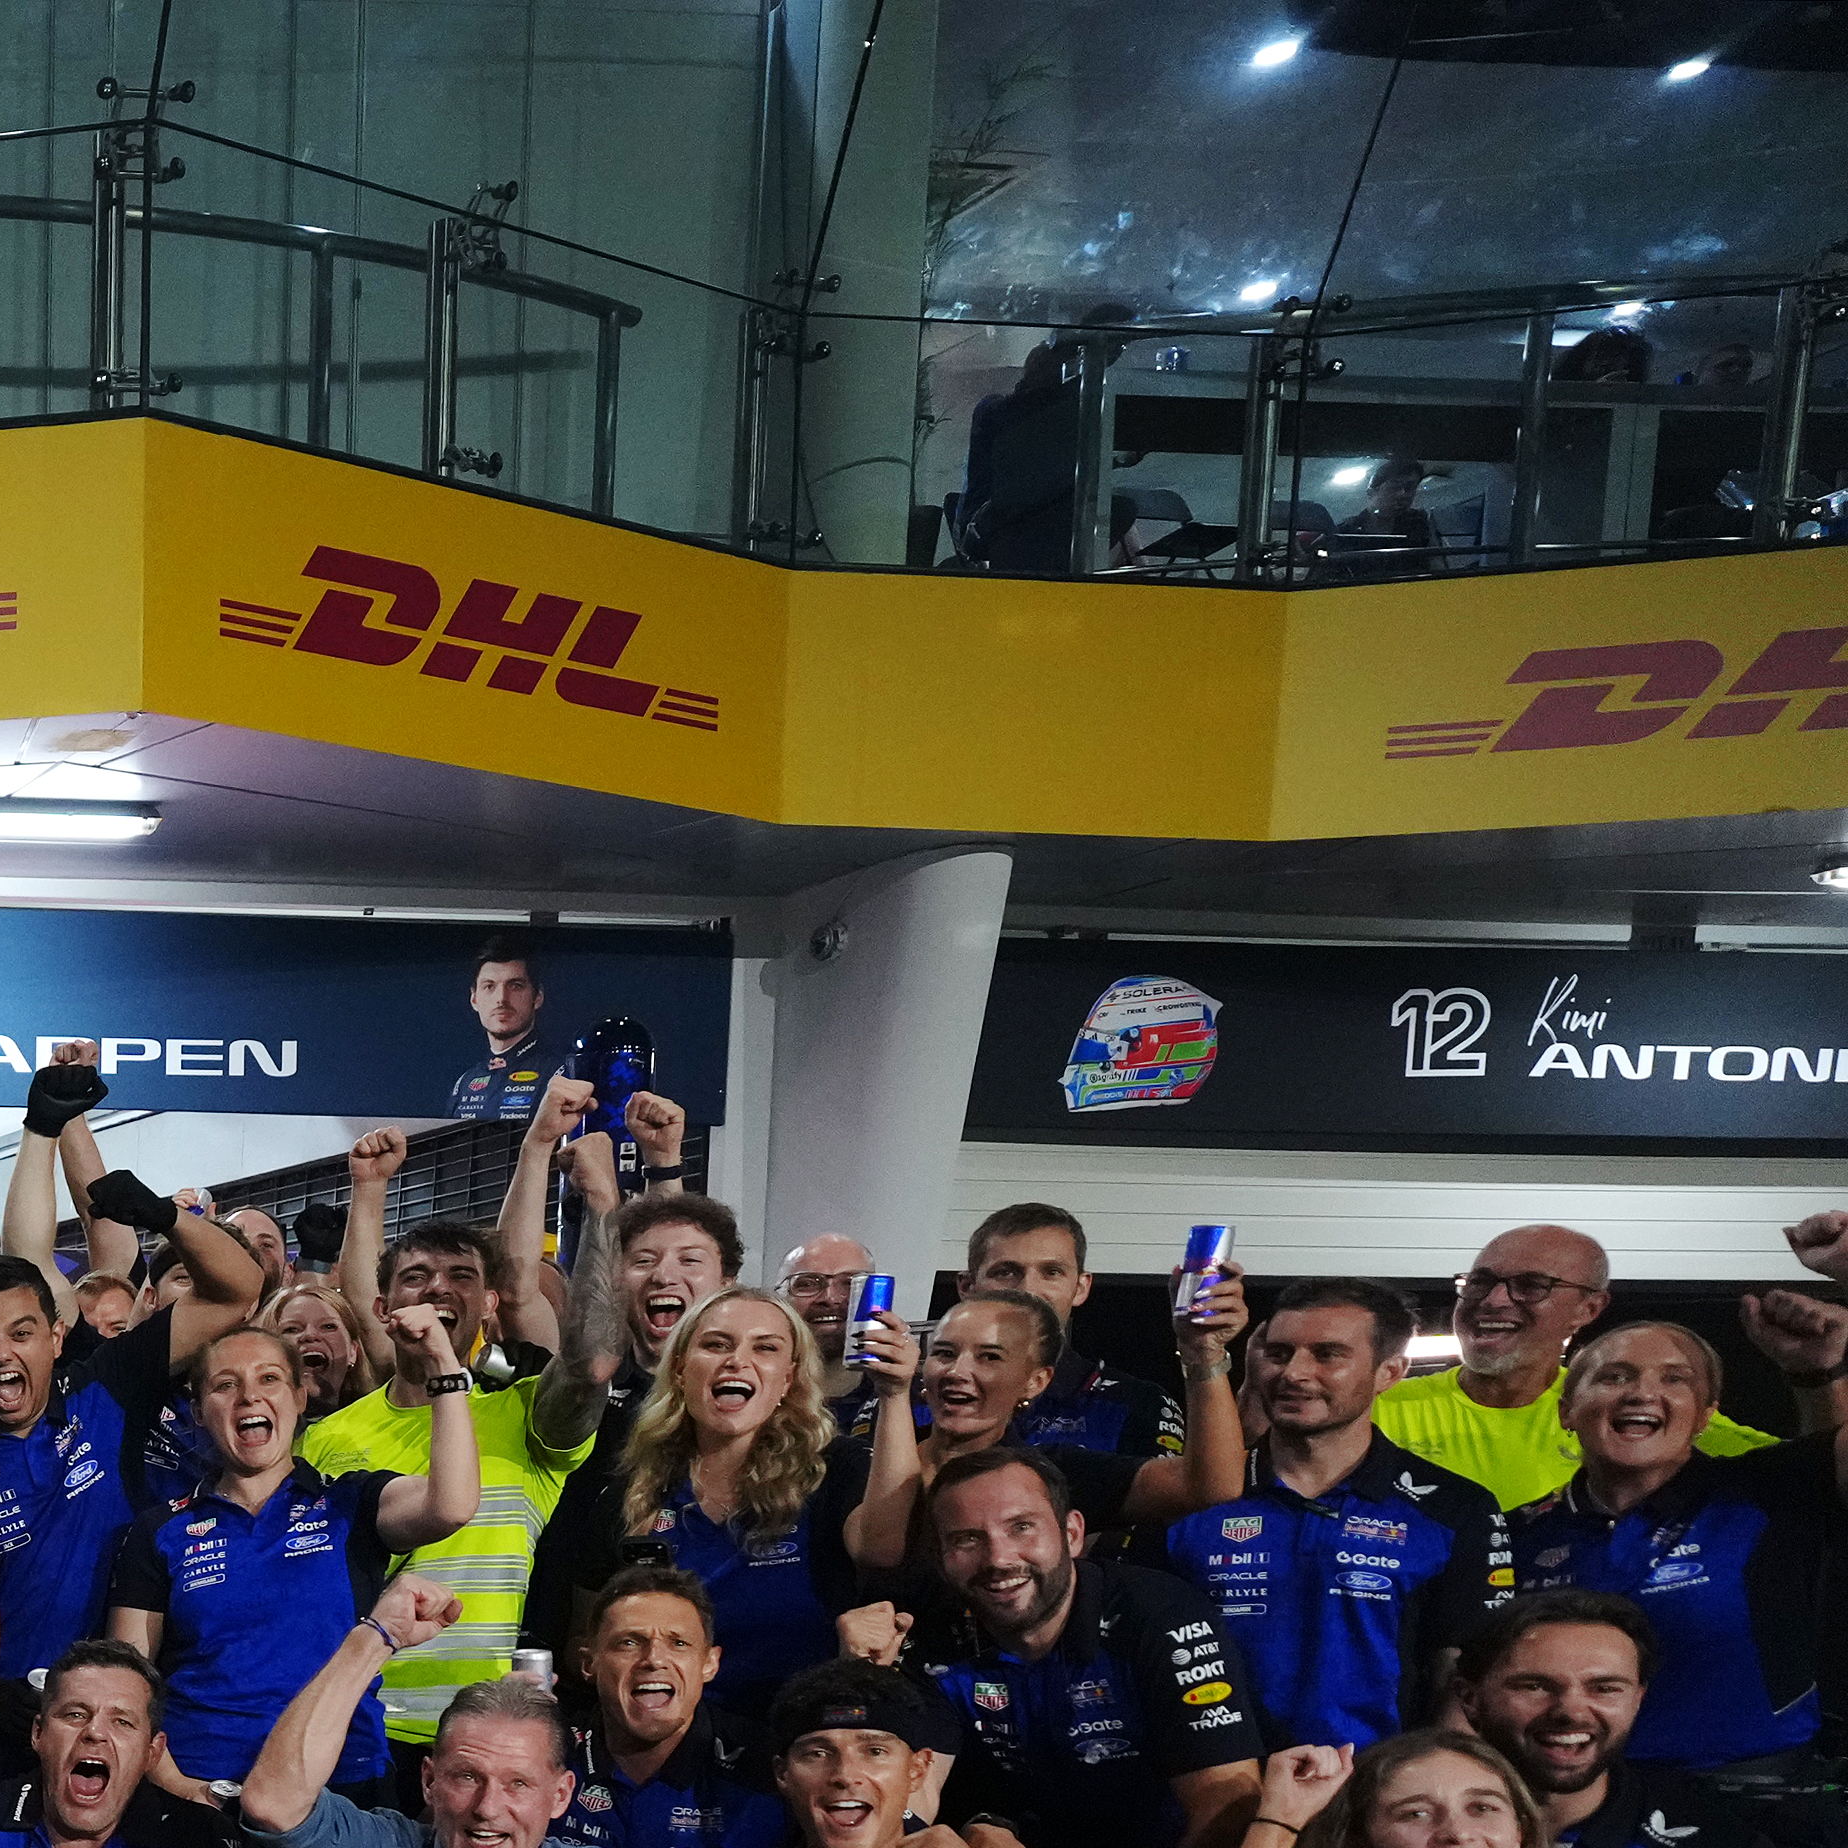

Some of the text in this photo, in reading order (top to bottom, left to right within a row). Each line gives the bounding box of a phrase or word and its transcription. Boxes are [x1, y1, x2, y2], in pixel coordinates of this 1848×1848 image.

[292, 543, 660, 718] DHL
[1122, 986, 1185, 1000] SOLERA
[1527, 973, 1613, 1047] Kimi
[1391, 987, 1491, 1078] 12
[65, 1469, 106, 1500] RACING
[1225, 1518, 1261, 1528] TAG
[1346, 1515, 1408, 1531] ORACLE
[1223, 1527, 1261, 1541] HEUER
[182, 1551, 227, 1567] ORACLE
[283, 1544, 334, 1558] RACING
[1208, 1552, 1253, 1566] Mobil
[1352, 1553, 1401, 1569] Gate
[183, 1562, 226, 1579] CARLYLE
[1207, 1571, 1269, 1582] ORACLE
[1166, 1620, 1215, 1644] VISA
[1193, 1640, 1221, 1659] AT&T
[1174, 1659, 1226, 1686] ROKT
[1188, 1710, 1244, 1731] TRADE
